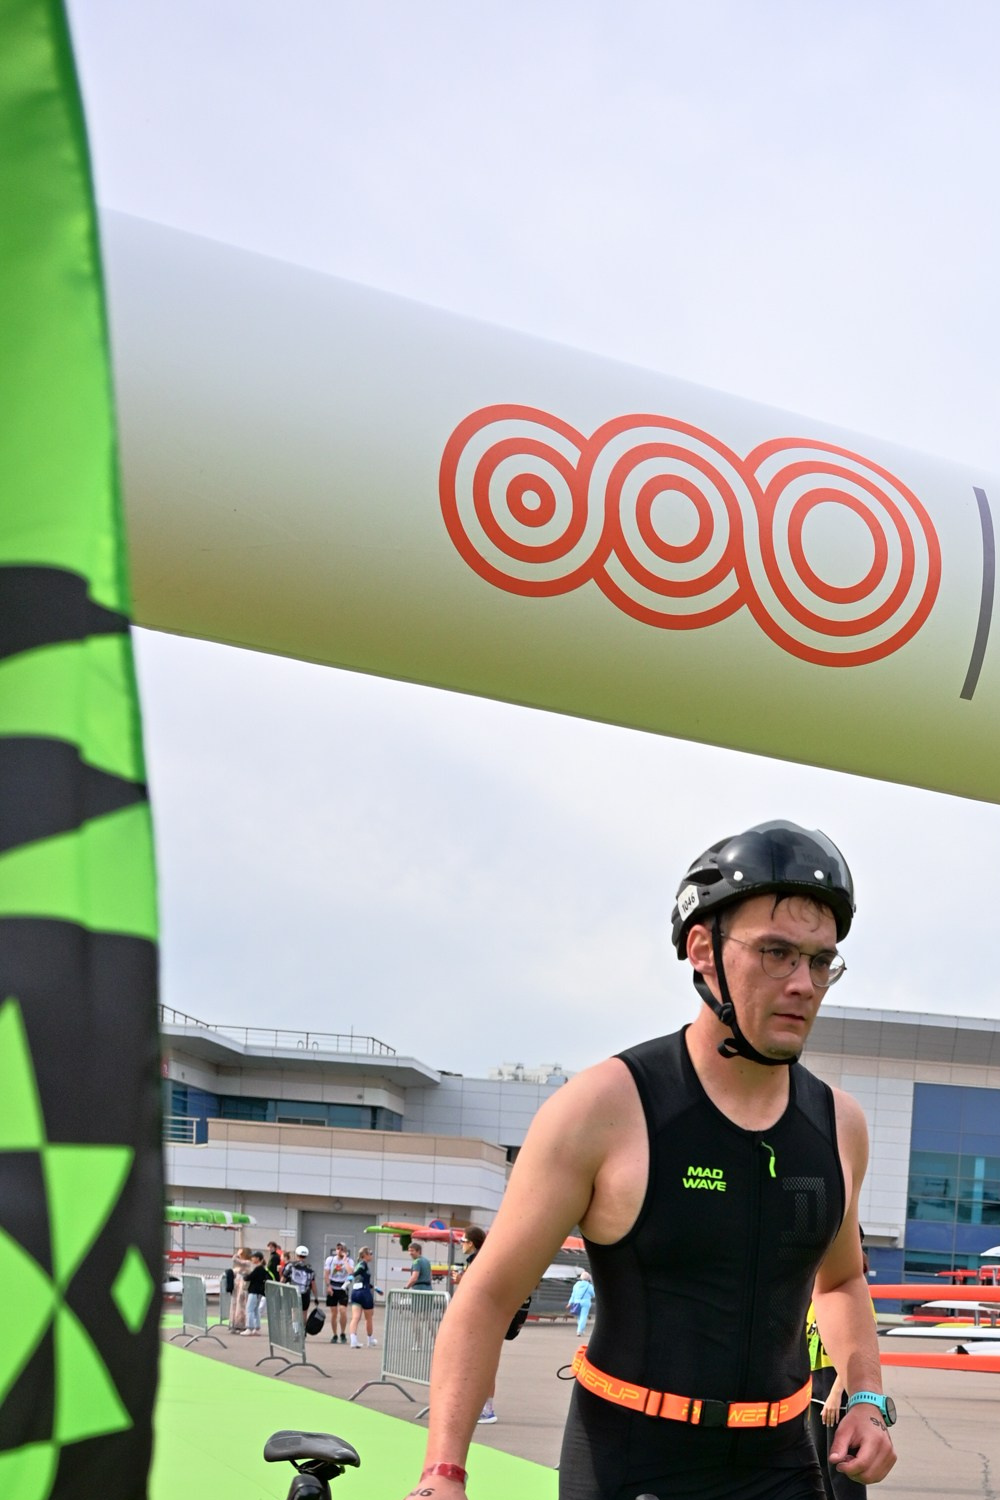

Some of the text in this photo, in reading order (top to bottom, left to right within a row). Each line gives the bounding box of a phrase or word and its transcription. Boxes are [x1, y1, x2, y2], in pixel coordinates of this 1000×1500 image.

[681, 892, 696, 913] 1046
[687, 1166, 724, 1180] MAD
[682, 1177, 727, 1192] WAVE
